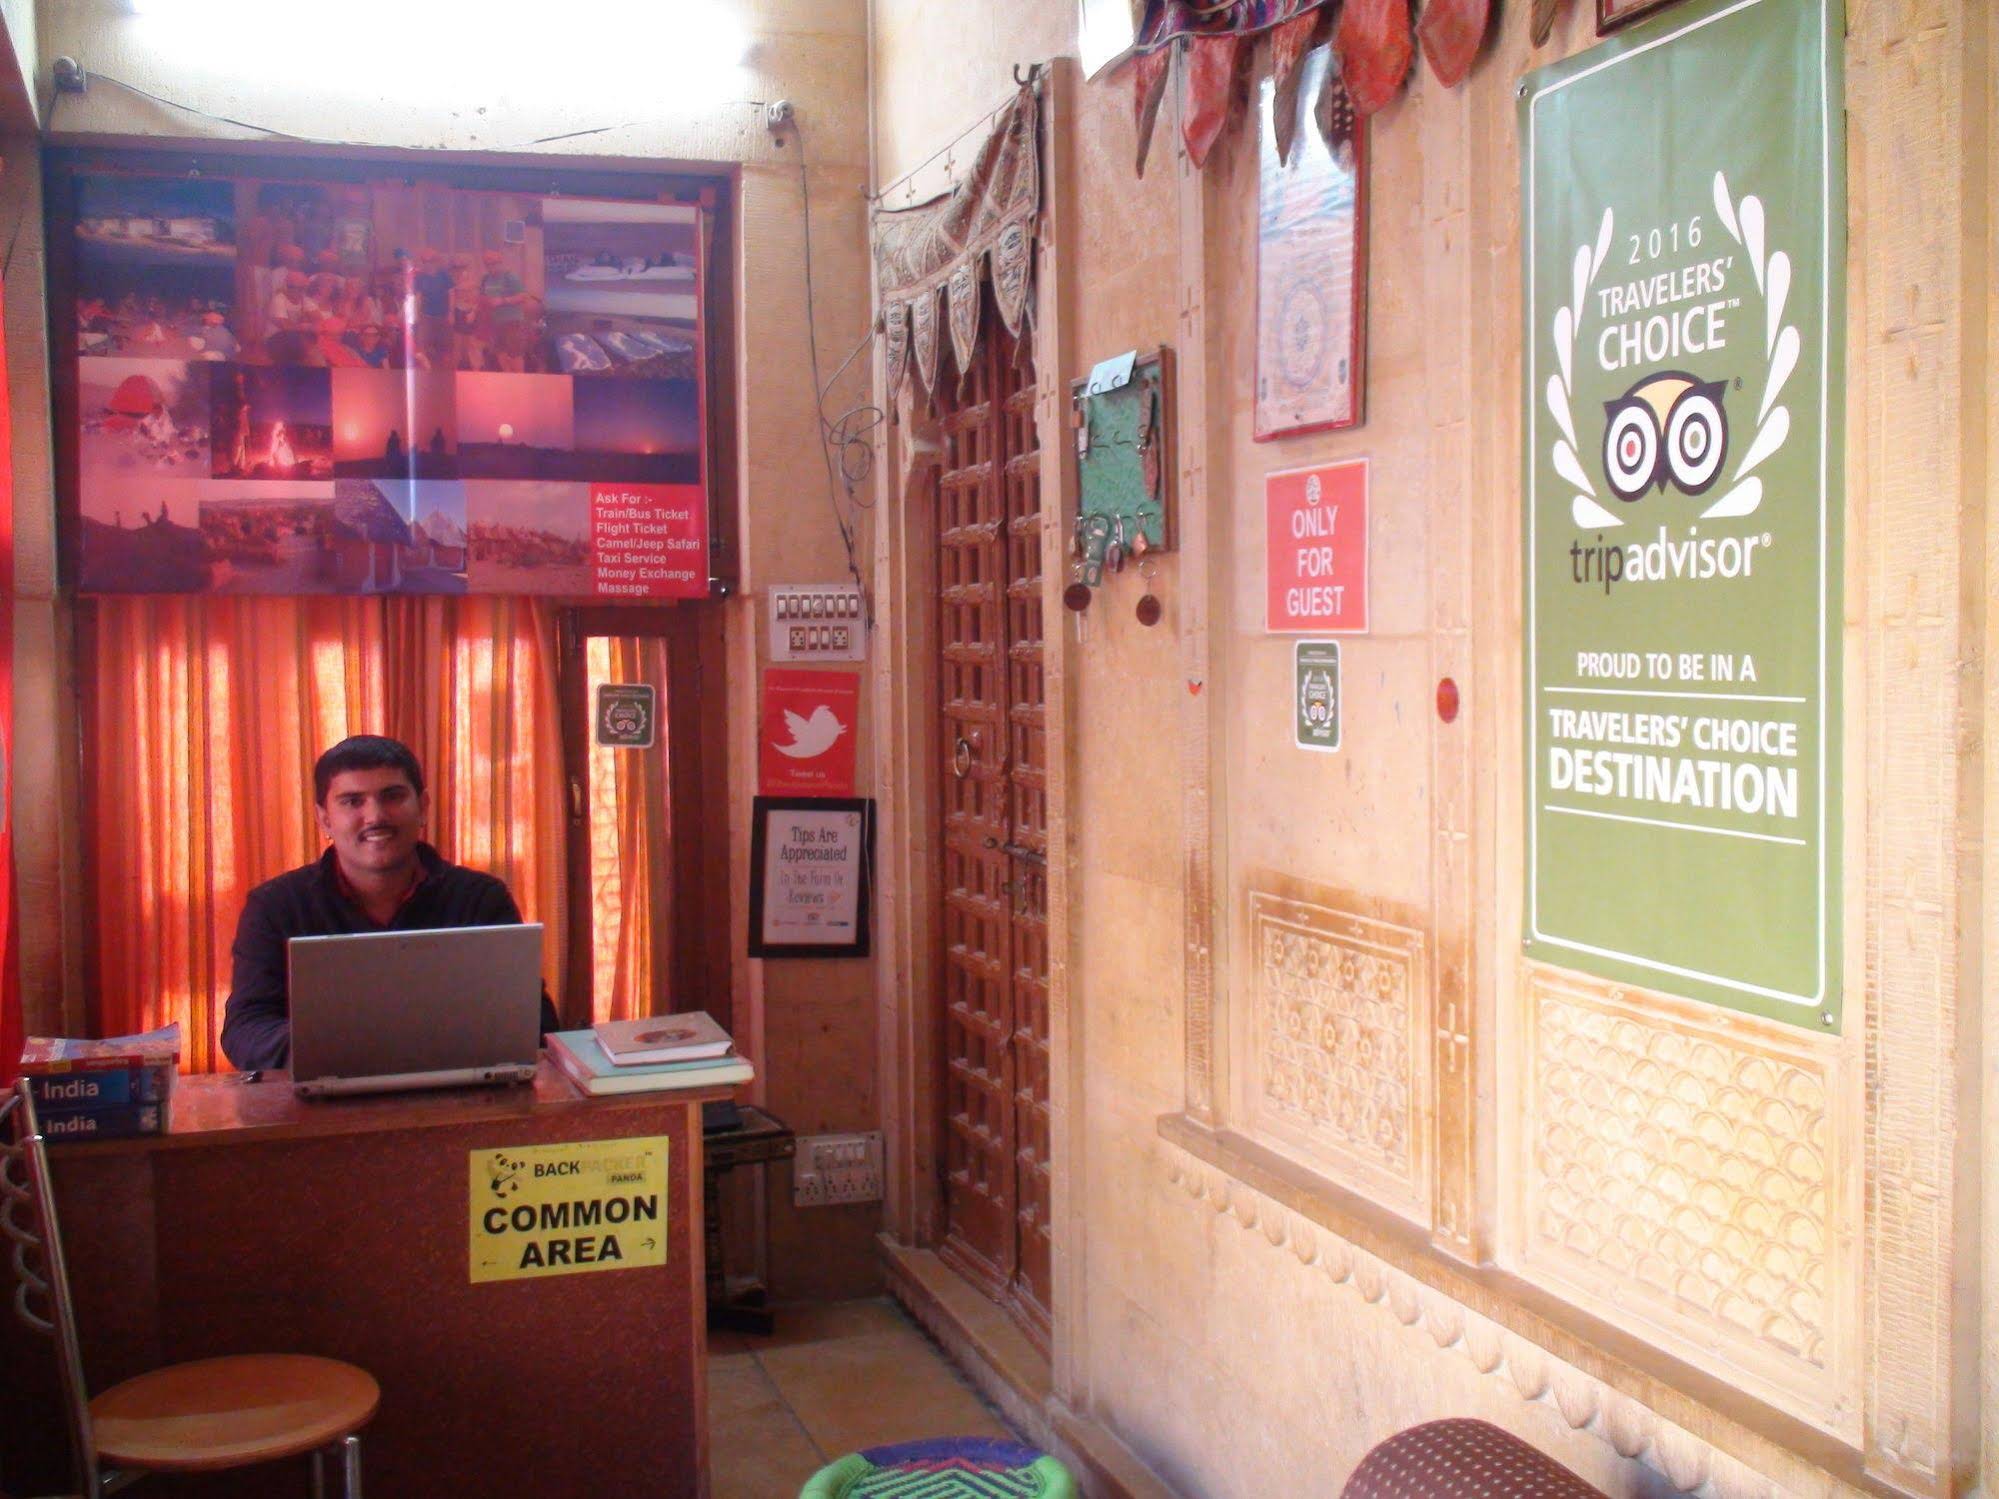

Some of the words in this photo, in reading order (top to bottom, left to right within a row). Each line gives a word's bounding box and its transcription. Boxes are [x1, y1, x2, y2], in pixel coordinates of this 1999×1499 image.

[1628, 216, 1702, 265] 2016
[1598, 256, 1733, 318] TRAVELERS'
[596, 493, 618, 504] Ask
[621, 493, 641, 504] For
[596, 507, 651, 519] Train/Bus
[654, 508, 689, 520] Ticket
[1291, 506, 1338, 539] ONLY
[597, 522, 630, 536] Flight
[633, 523, 668, 534] Ticket
[597, 537, 664, 551] Camel/Jeep
[667, 538, 700, 550] Safari
[597, 552, 621, 563] Taxi
[624, 552, 667, 564] Service
[1297, 546, 1334, 578] FOR
[597, 567, 636, 580] Money
[640, 568, 696, 581] Exchange
[598, 582, 650, 596] Massage
[1286, 585, 1344, 617] GUEST
[1577, 652, 1641, 679] PROUD
[1646, 653, 1672, 680] TO
[1679, 654, 1704, 681] BE
[1710, 654, 1733, 681] IN
[1739, 655, 1757, 682] A
[1549, 708, 1688, 748] TRAVELERS'
[1693, 717, 1798, 757] CHOICE
[1549, 746, 1798, 818] DESTINATION
[792, 826, 815, 845] Tips
[819, 828, 838, 844] Are
[780, 845, 848, 863] Appreciated
[43, 1079, 100, 1100] India
[47, 1115, 97, 1133] India
[610, 1173, 644, 1184] PANDA
[483, 1194, 658, 1235] COMMON
[519, 1234, 623, 1269] AREA
